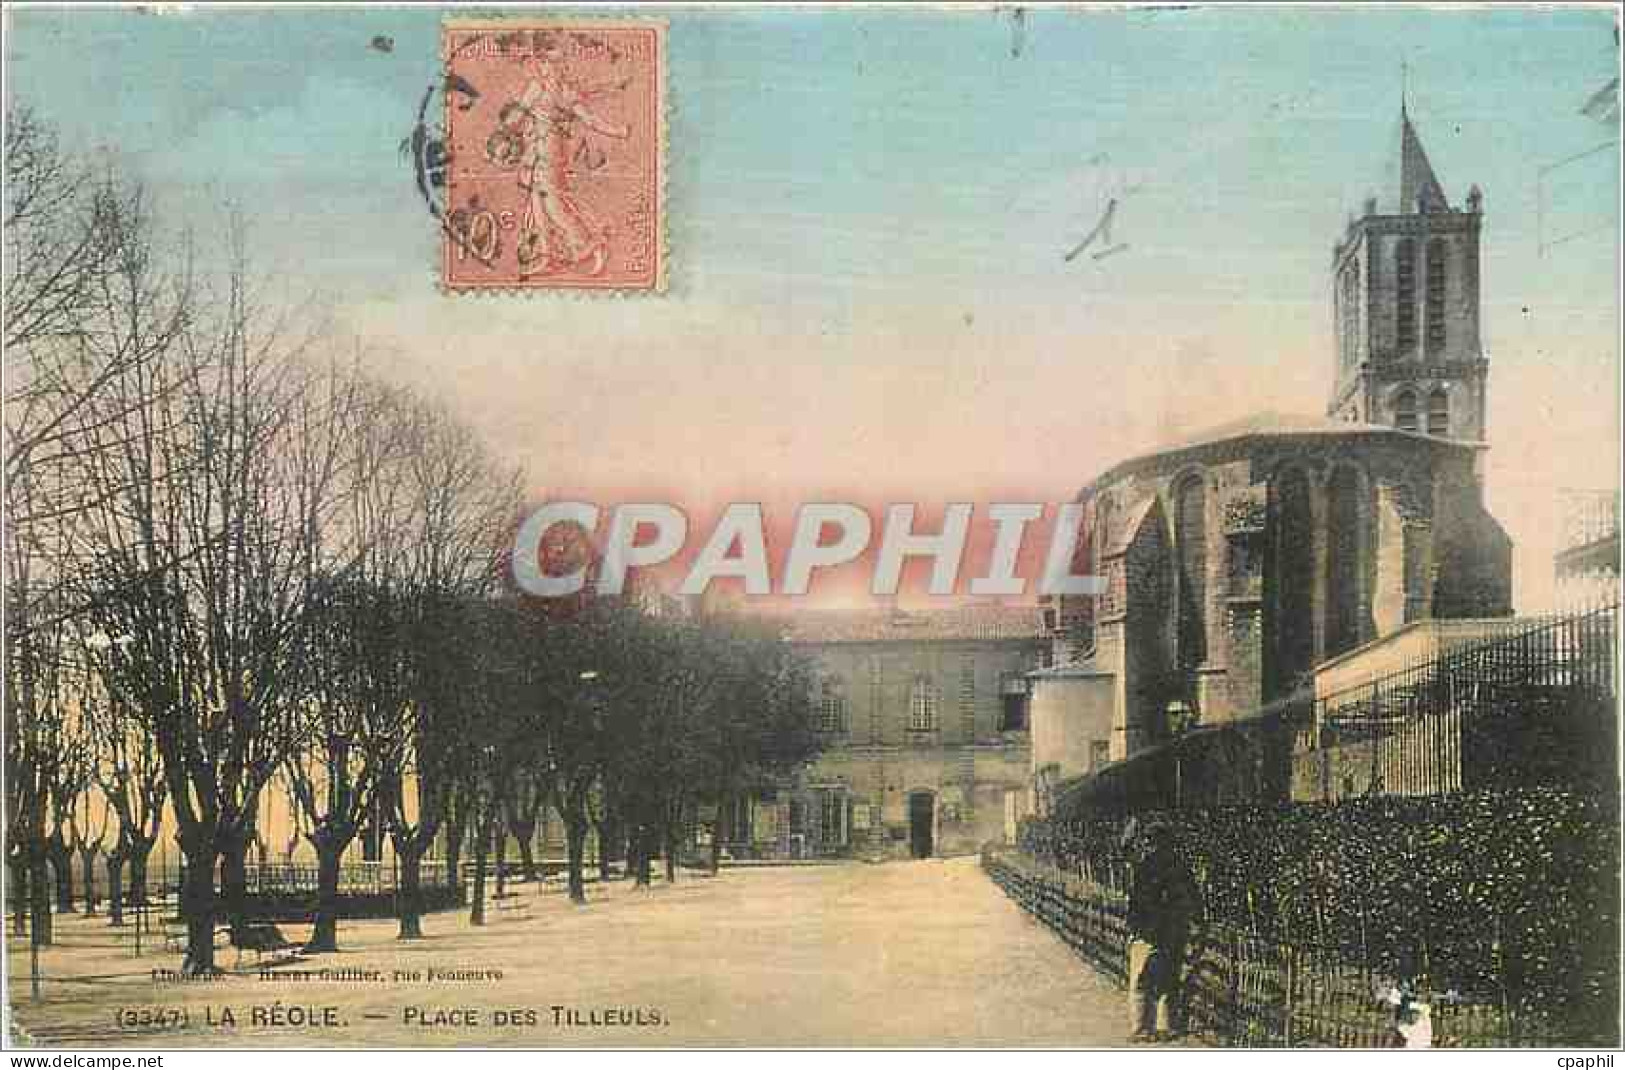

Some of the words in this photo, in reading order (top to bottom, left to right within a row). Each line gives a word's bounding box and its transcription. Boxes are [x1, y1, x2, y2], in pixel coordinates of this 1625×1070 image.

[394, 970, 421, 982] rue
[205, 1006, 236, 1027] LA
[251, 1000, 349, 1027] RÉOLE.
[403, 1006, 478, 1027] PLACE
[493, 1009, 537, 1027] DES
[550, 1005, 671, 1027] TILLEULS.
